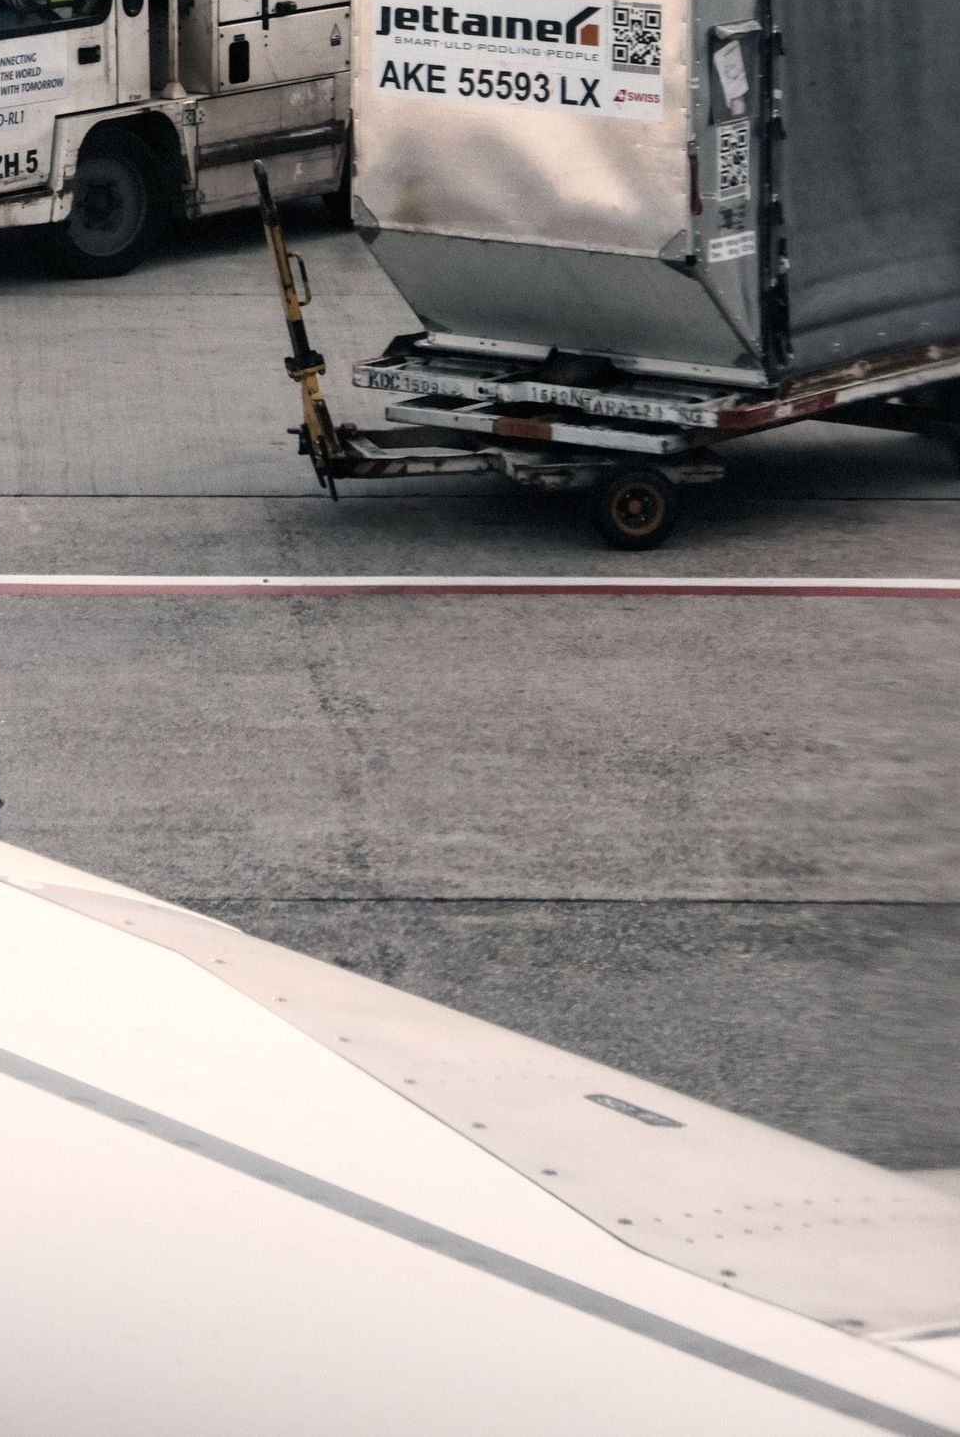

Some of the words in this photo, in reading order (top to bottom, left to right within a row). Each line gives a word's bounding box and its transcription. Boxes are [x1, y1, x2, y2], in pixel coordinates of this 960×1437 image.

[376, 5, 602, 45] jettainer
[0, 71, 14, 81] THE
[15, 67, 42, 79] WORLD
[380, 60, 446, 94] AKE
[458, 67, 551, 103] 55593
[561, 76, 601, 108] LX
[0, 83, 19, 96] WITH
[21, 77, 65, 93] TOMORROW
[627, 92, 661, 103] SWISS
[26, 149, 39, 174] 5
